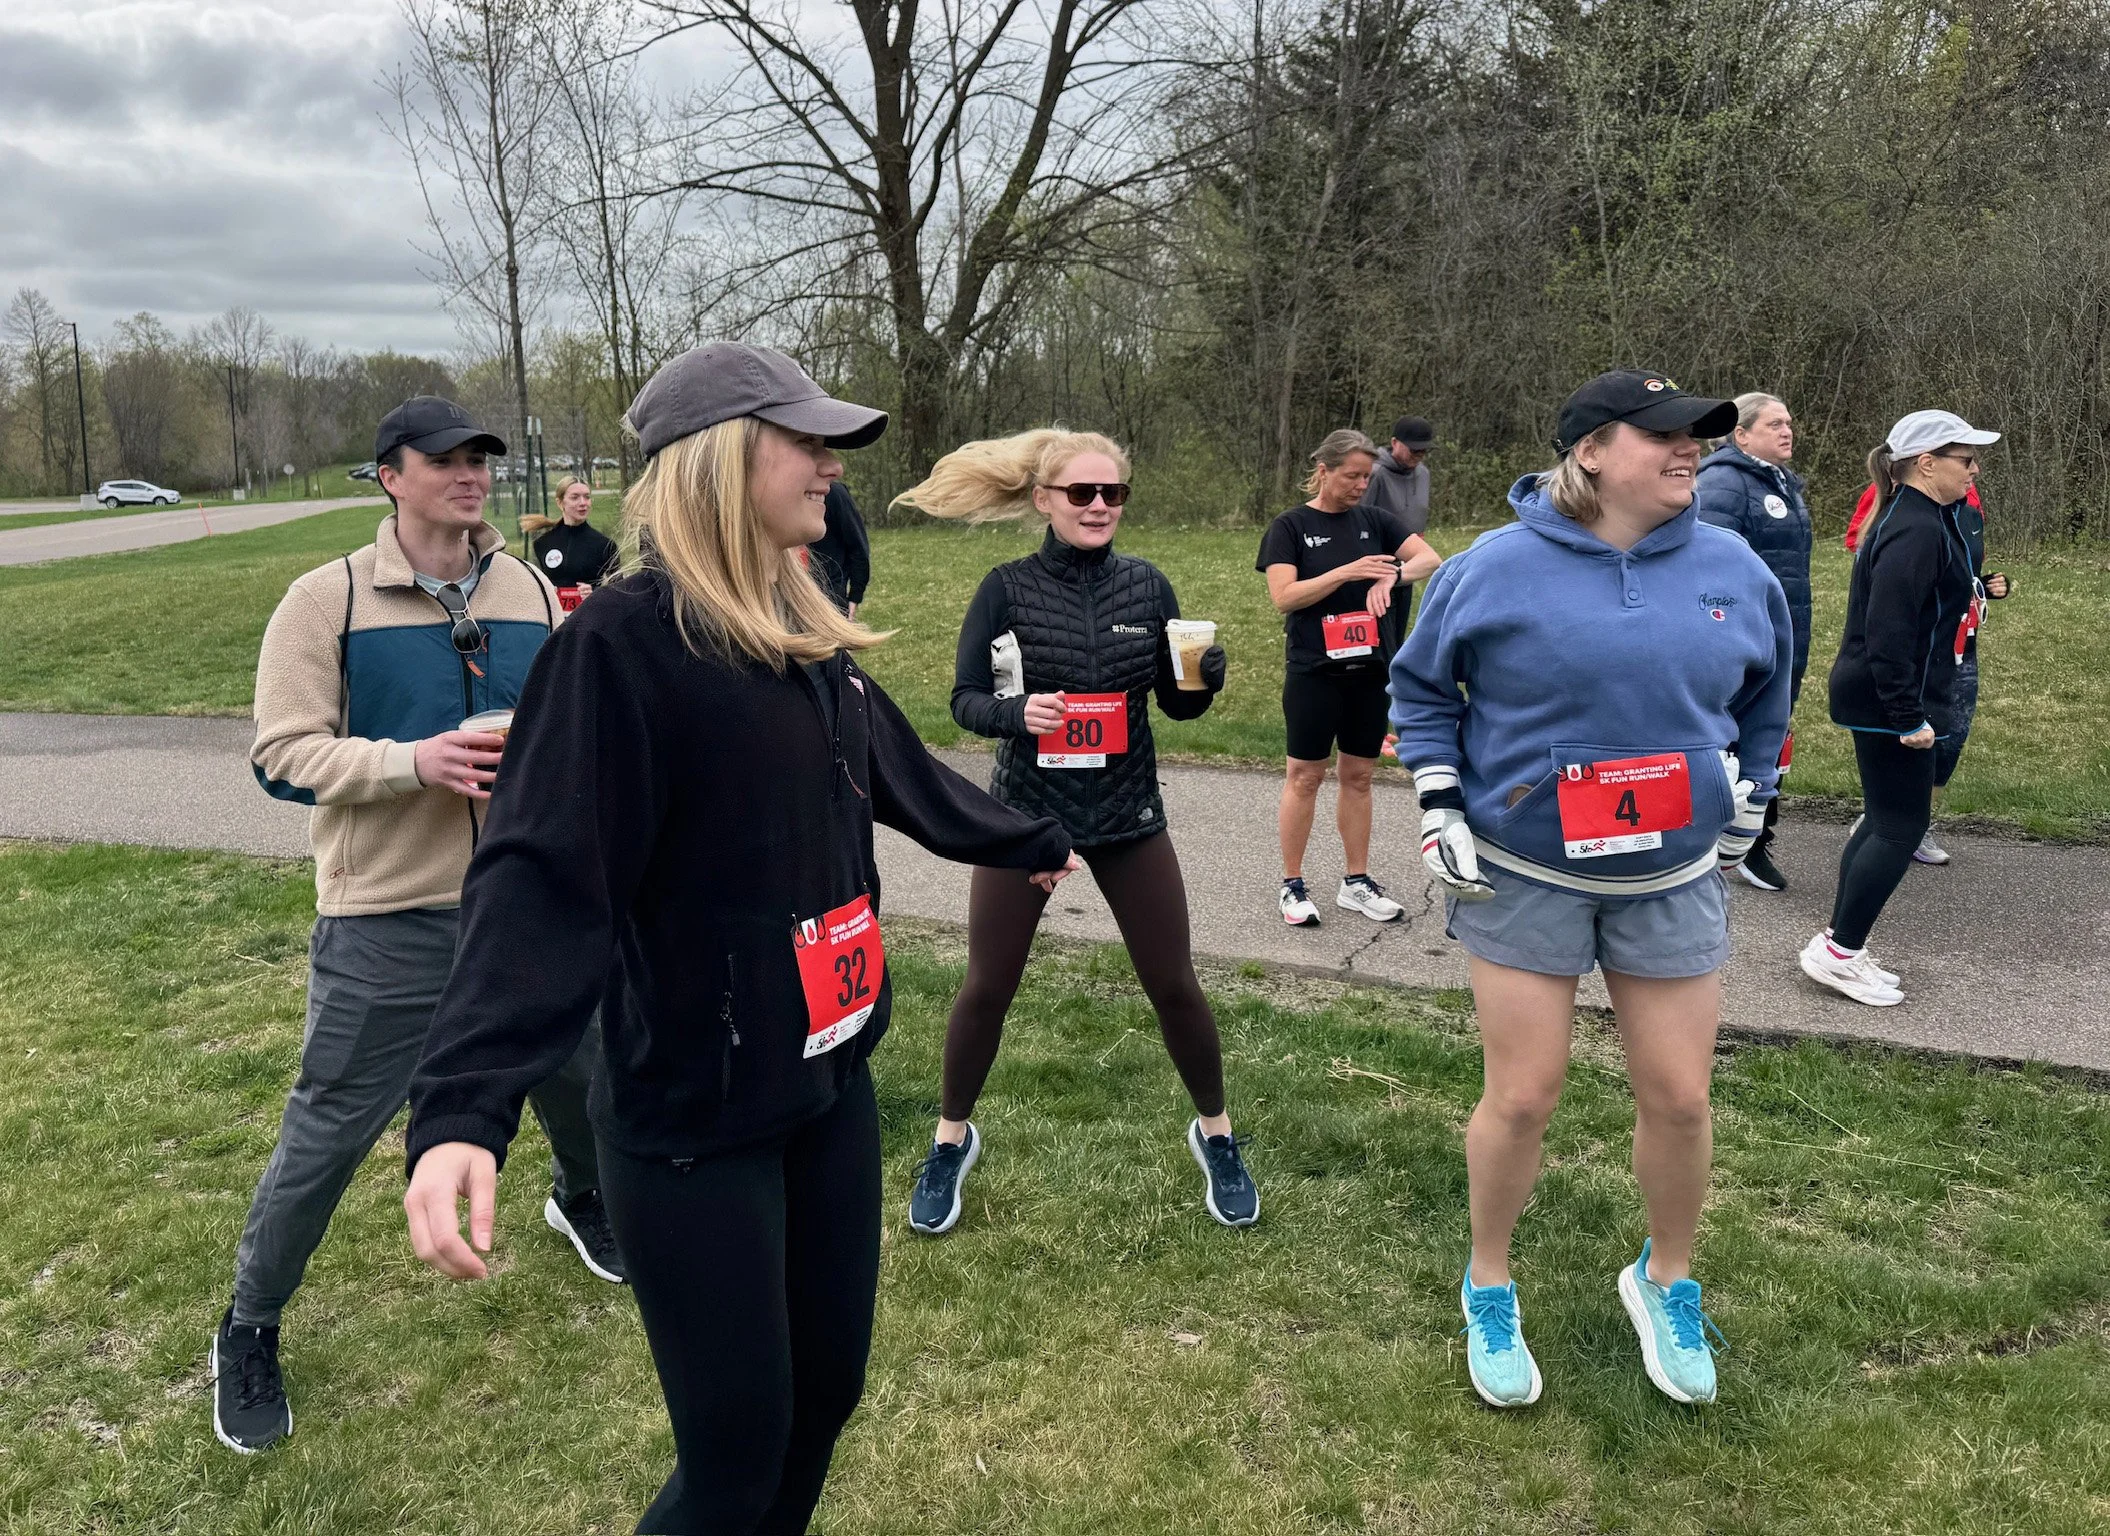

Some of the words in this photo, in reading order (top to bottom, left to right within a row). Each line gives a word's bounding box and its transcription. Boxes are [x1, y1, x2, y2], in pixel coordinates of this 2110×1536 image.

[562, 597, 577, 610] 73
[1119, 624, 1147, 633] Proterra
[1344, 625, 1366, 643] 40
[1066, 719, 1103, 747] 80
[1624, 765, 1664, 776] GRANTING
[1664, 763, 1681, 771] LIFE
[1611, 776, 1628, 784] FUN
[1628, 771, 1670, 782] RUN/WALK
[1615, 789, 1641, 827] 4
[835, 947, 870, 1008] 32
